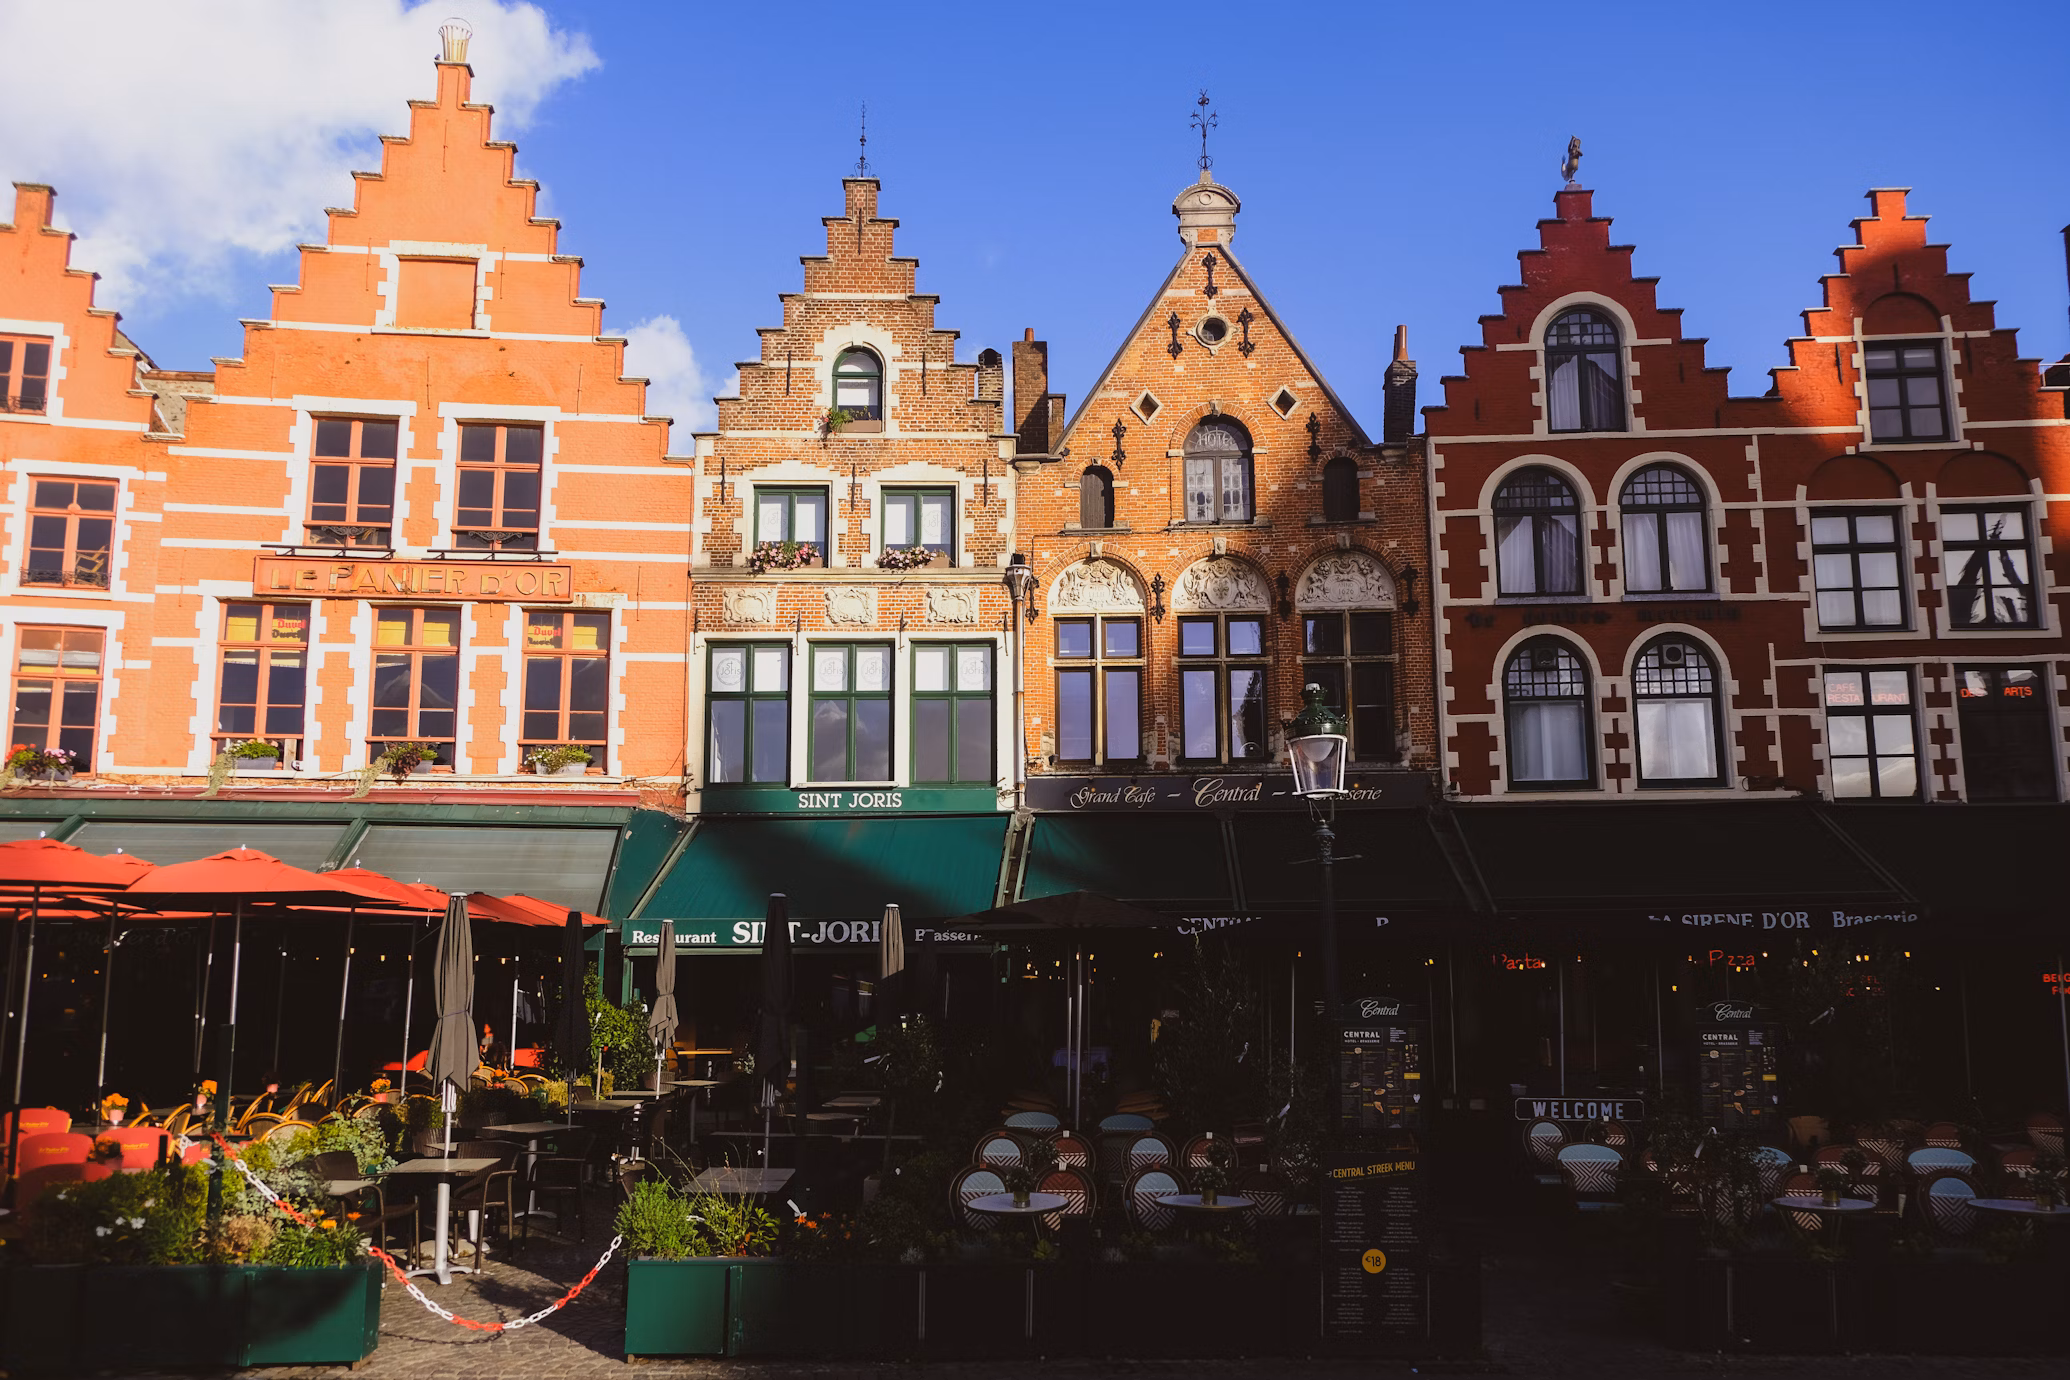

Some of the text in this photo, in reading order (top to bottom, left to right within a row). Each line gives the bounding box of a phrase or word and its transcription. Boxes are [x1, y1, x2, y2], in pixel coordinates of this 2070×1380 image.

[271, 564, 565, 596] LE PANIER D'OR
[277, 617, 306, 629] Duvel
[533, 626, 562, 637] Duvel
[1829, 682, 1856, 692] CAFE
[2003, 686, 2033, 697] ARTS
[798, 792, 903, 809] SINT JORIS
[1070, 786, 1121, 808] Grand
[1123, 785, 1156, 808] Cafe
[1192, 777, 1264, 808] Central
[1761, 911, 1811, 929] D'OR
[632, 930, 717, 944] Resurant
[1709, 949, 1755, 969] Pzza
[1360, 999, 1400, 1018] Central
[1714, 1003, 1754, 1021] Central
[1343, 1031, 1380, 1039] CENTRAL
[1702, 1033, 1739, 1041] CENTRAL
[1532, 1101, 1625, 1119] WELCOME
[1333, 1166, 1365, 1179] CENTRAL
[1367, 1162, 1394, 1175] STREEK
[1395, 1160, 1416, 1172] MENU
[1365, 1255, 1382, 1267] €18
